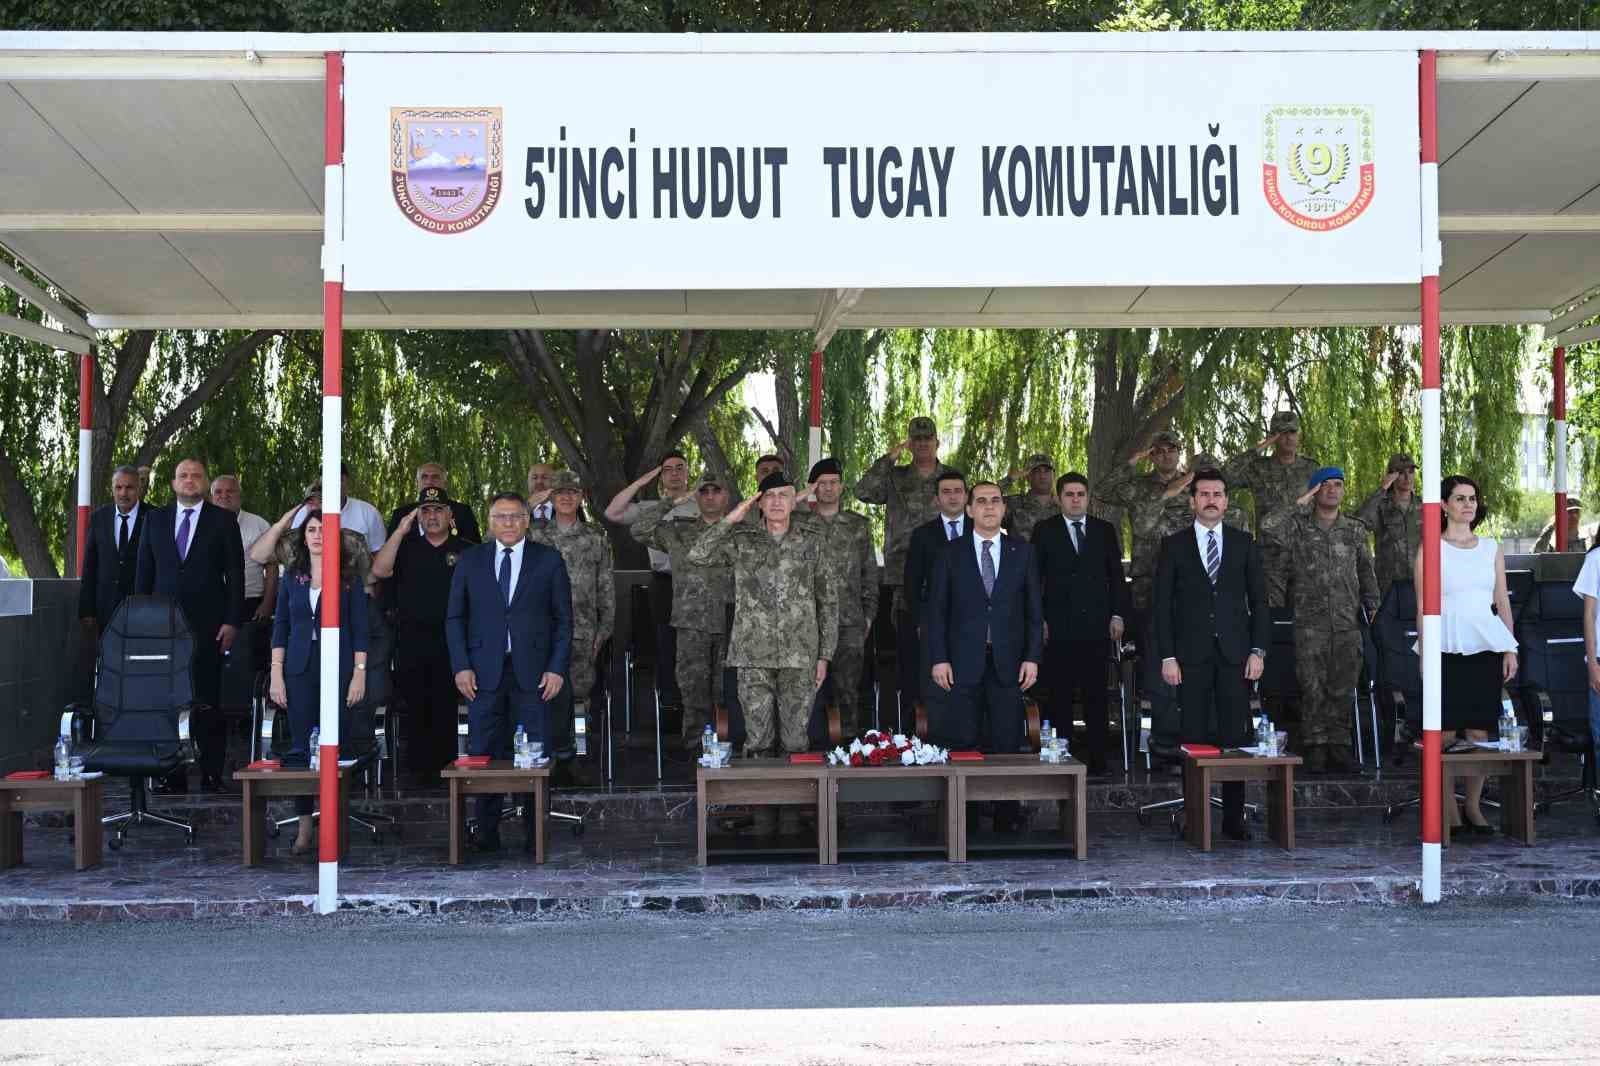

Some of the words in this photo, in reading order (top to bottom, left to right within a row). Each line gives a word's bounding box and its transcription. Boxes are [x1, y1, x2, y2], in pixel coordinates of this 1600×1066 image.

[525, 126, 637, 219] 5'İNCİ
[653, 147, 787, 219] HUDUT
[824, 146, 955, 218] TUGAY
[982, 123, 1238, 217] KOMUTANLIĞI
[1307, 142, 1333, 176] 9
[414, 214, 444, 231] ORDU
